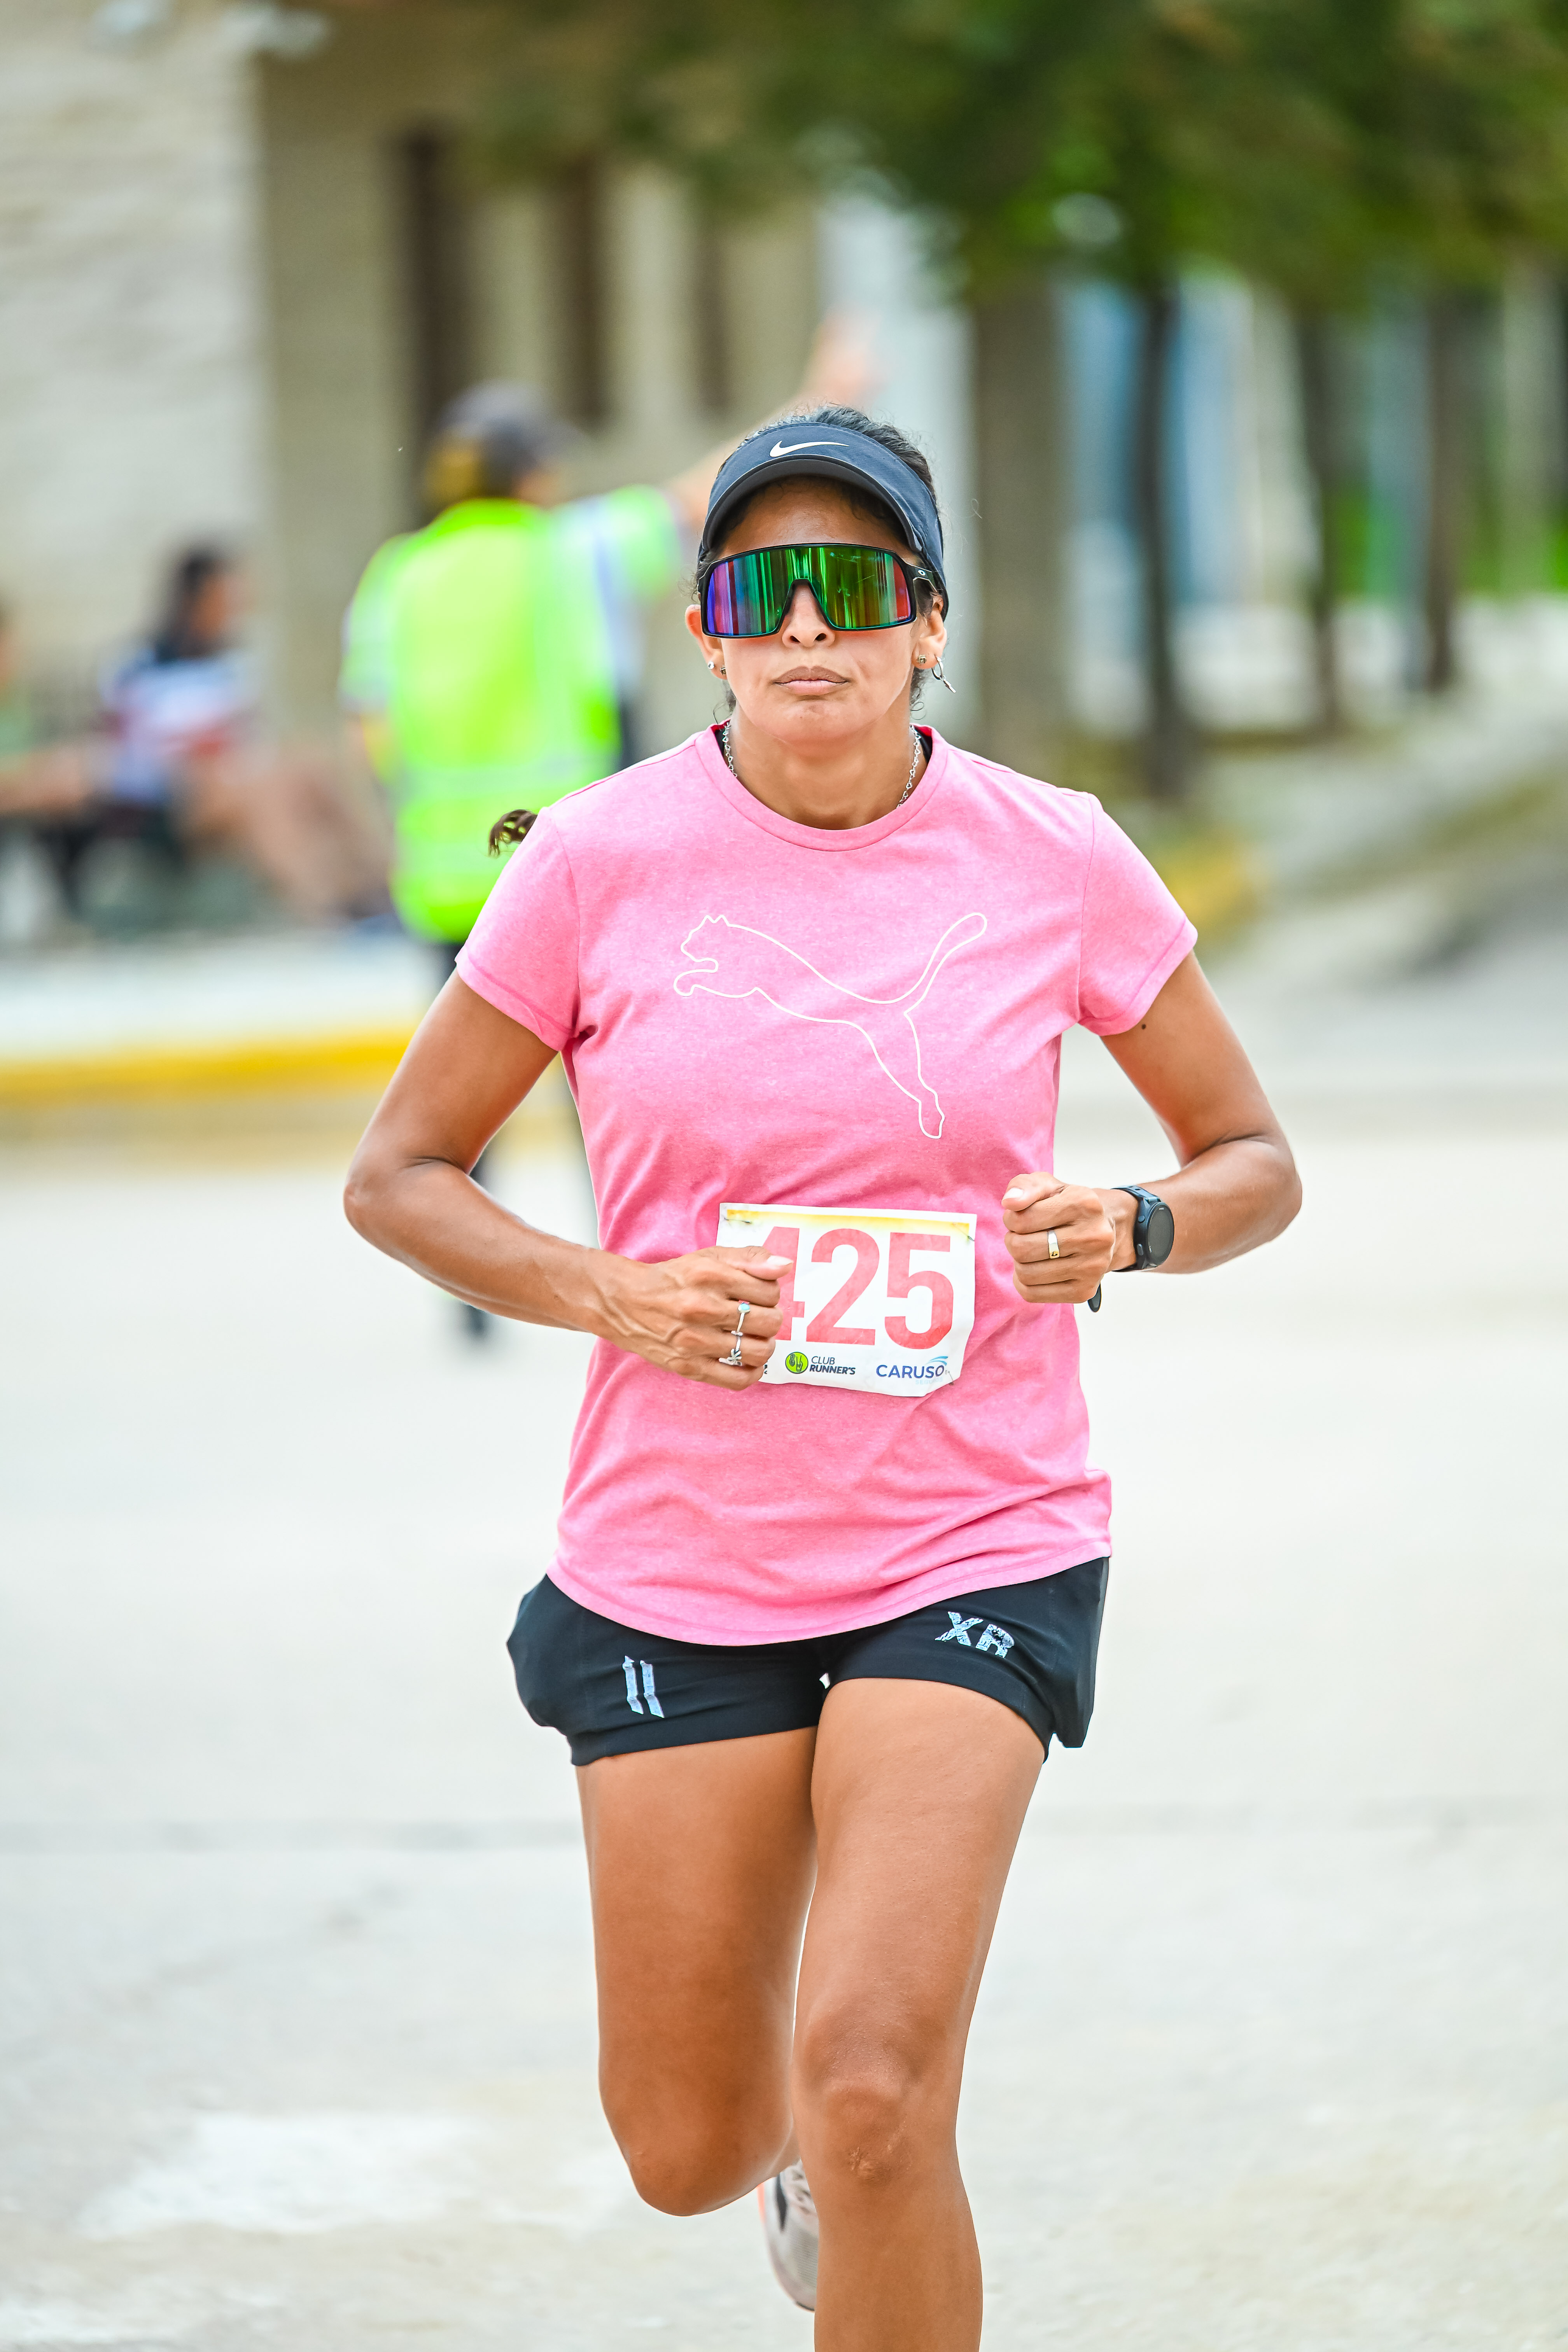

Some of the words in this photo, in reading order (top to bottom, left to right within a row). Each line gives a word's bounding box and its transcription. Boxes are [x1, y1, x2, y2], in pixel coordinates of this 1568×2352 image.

[761, 1226, 954, 1349] 425
[811, 1356, 835, 1365] CLUB
[809, 1364, 856, 1375] RUNNER'S
[876, 1365, 945, 1379] CARUSO
